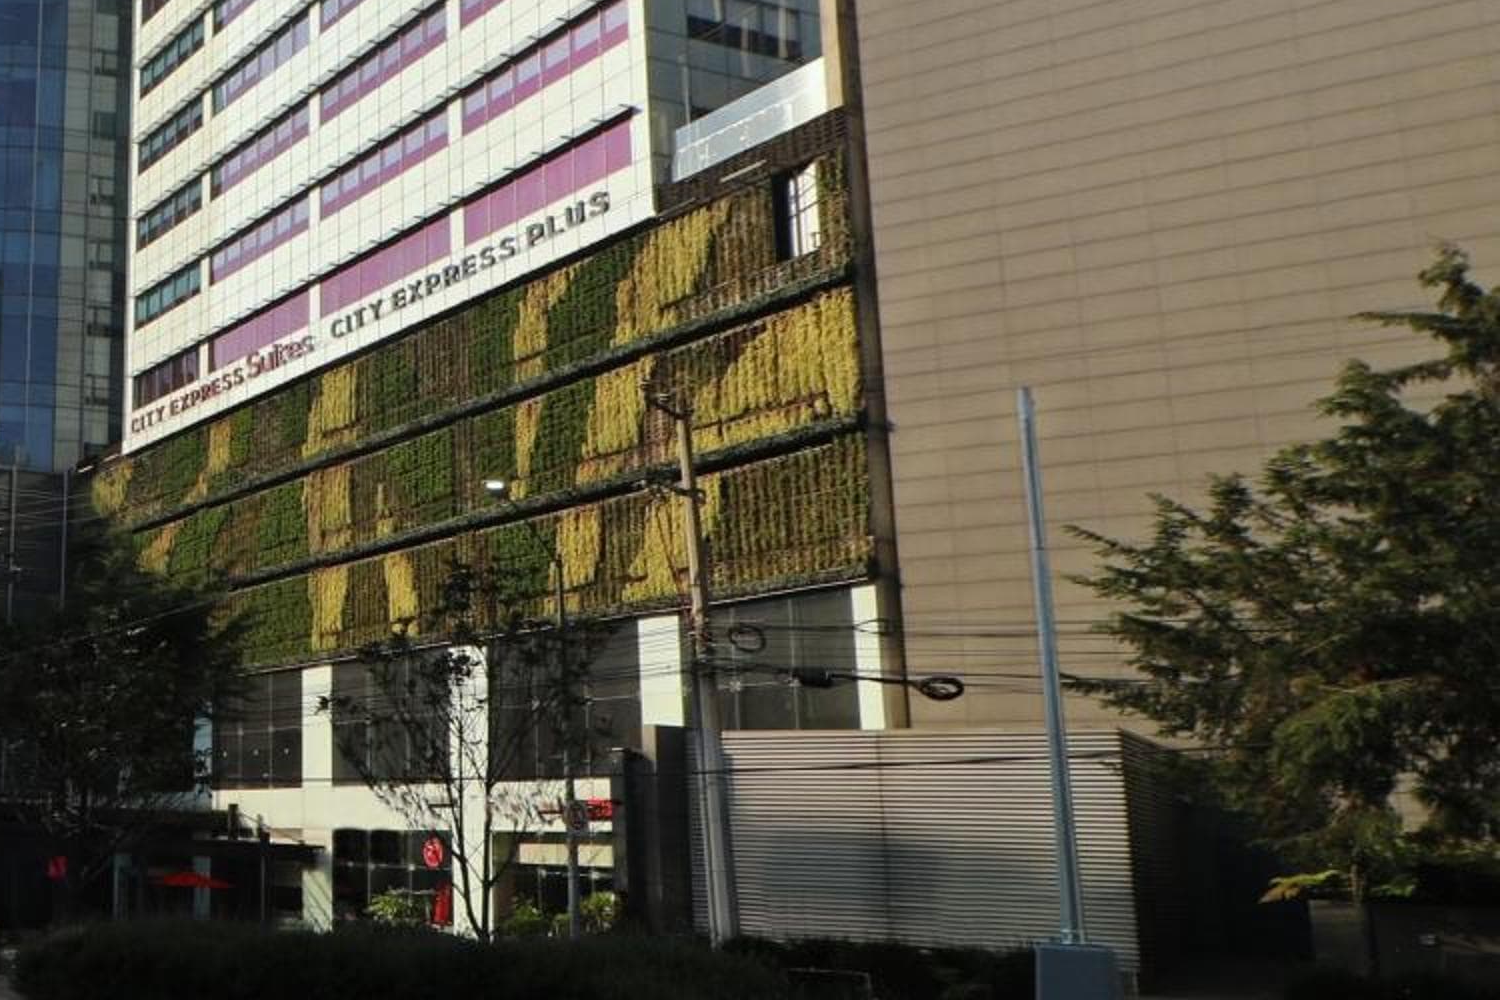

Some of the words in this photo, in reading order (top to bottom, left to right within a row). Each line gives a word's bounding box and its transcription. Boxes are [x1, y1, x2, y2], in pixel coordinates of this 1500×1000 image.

[330, 298, 384, 339] CITY
[390, 237, 517, 311] EXPRESS
[525, 191, 612, 248] PLUS
[131, 404, 166, 433] CITY
[169, 367, 245, 416] EXPRESS
[245, 335, 316, 379] Suites
